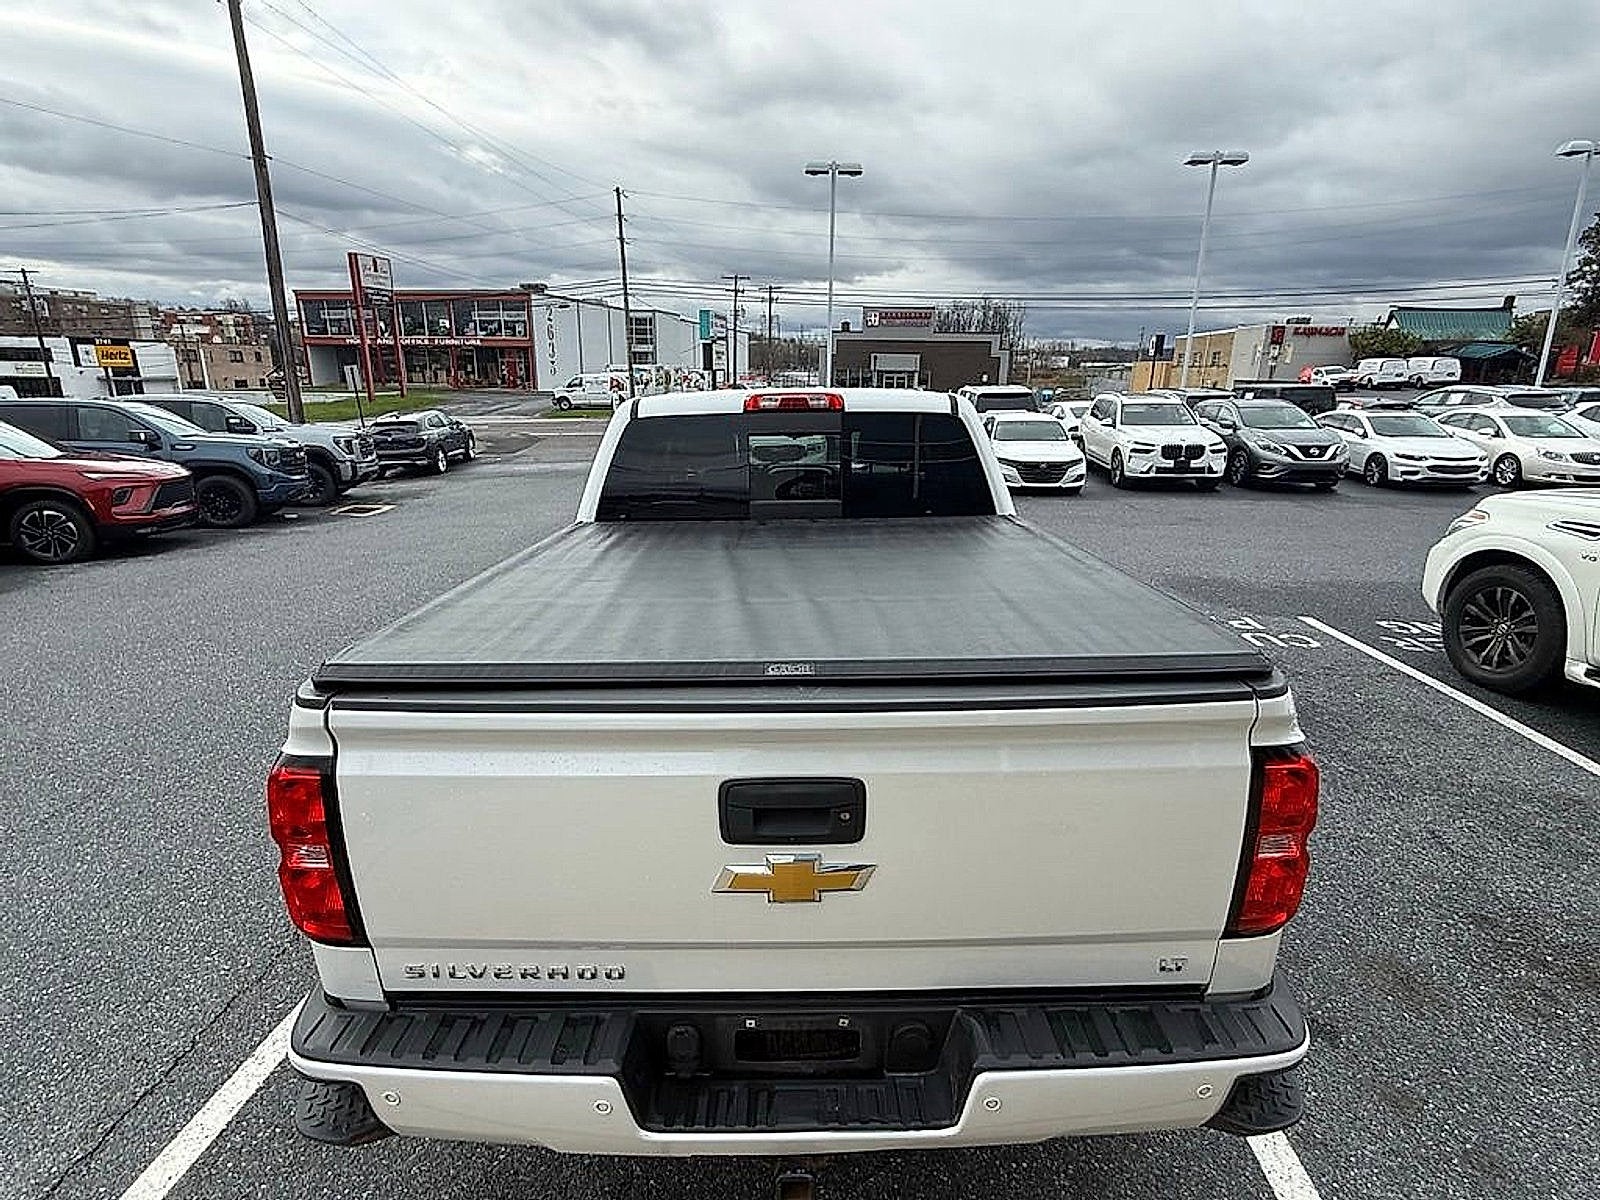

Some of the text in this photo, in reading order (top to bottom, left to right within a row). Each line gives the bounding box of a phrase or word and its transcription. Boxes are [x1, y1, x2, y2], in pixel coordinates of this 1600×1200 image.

[101, 350, 131, 361] Hertz
[404, 963, 626, 981] SILVERADO
[1158, 956, 1189, 972] LT
